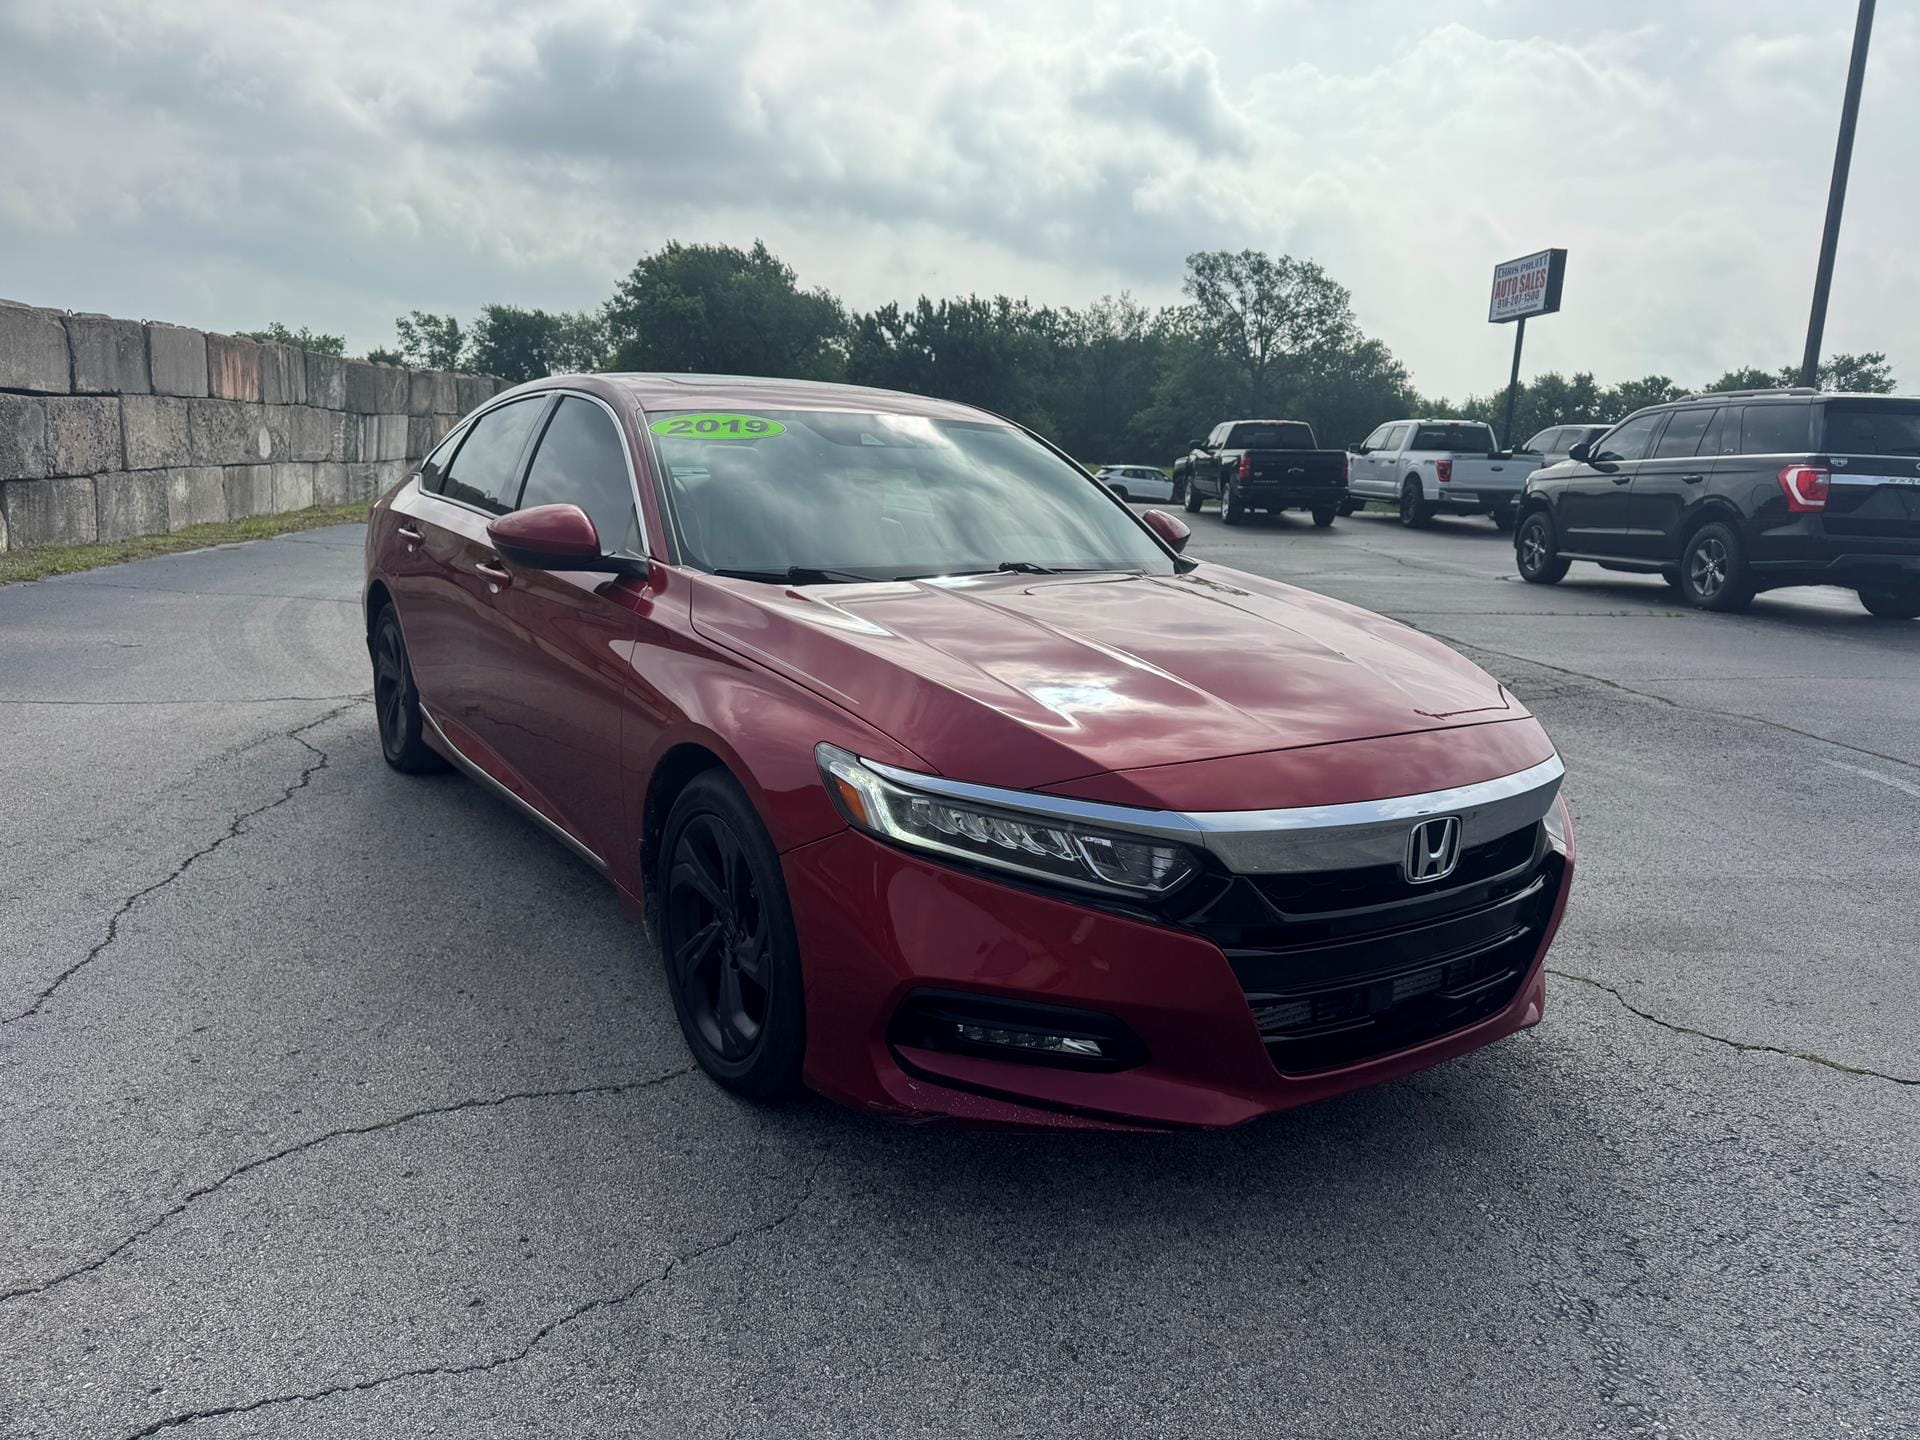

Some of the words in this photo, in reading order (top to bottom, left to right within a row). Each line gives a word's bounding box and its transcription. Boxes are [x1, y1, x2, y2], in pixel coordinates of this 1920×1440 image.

[1498, 266, 1519, 279] CHRIS
[1495, 277, 1518, 300] AUTO
[1519, 269, 1546, 293] SALES
[666, 419, 769, 434] 2019
